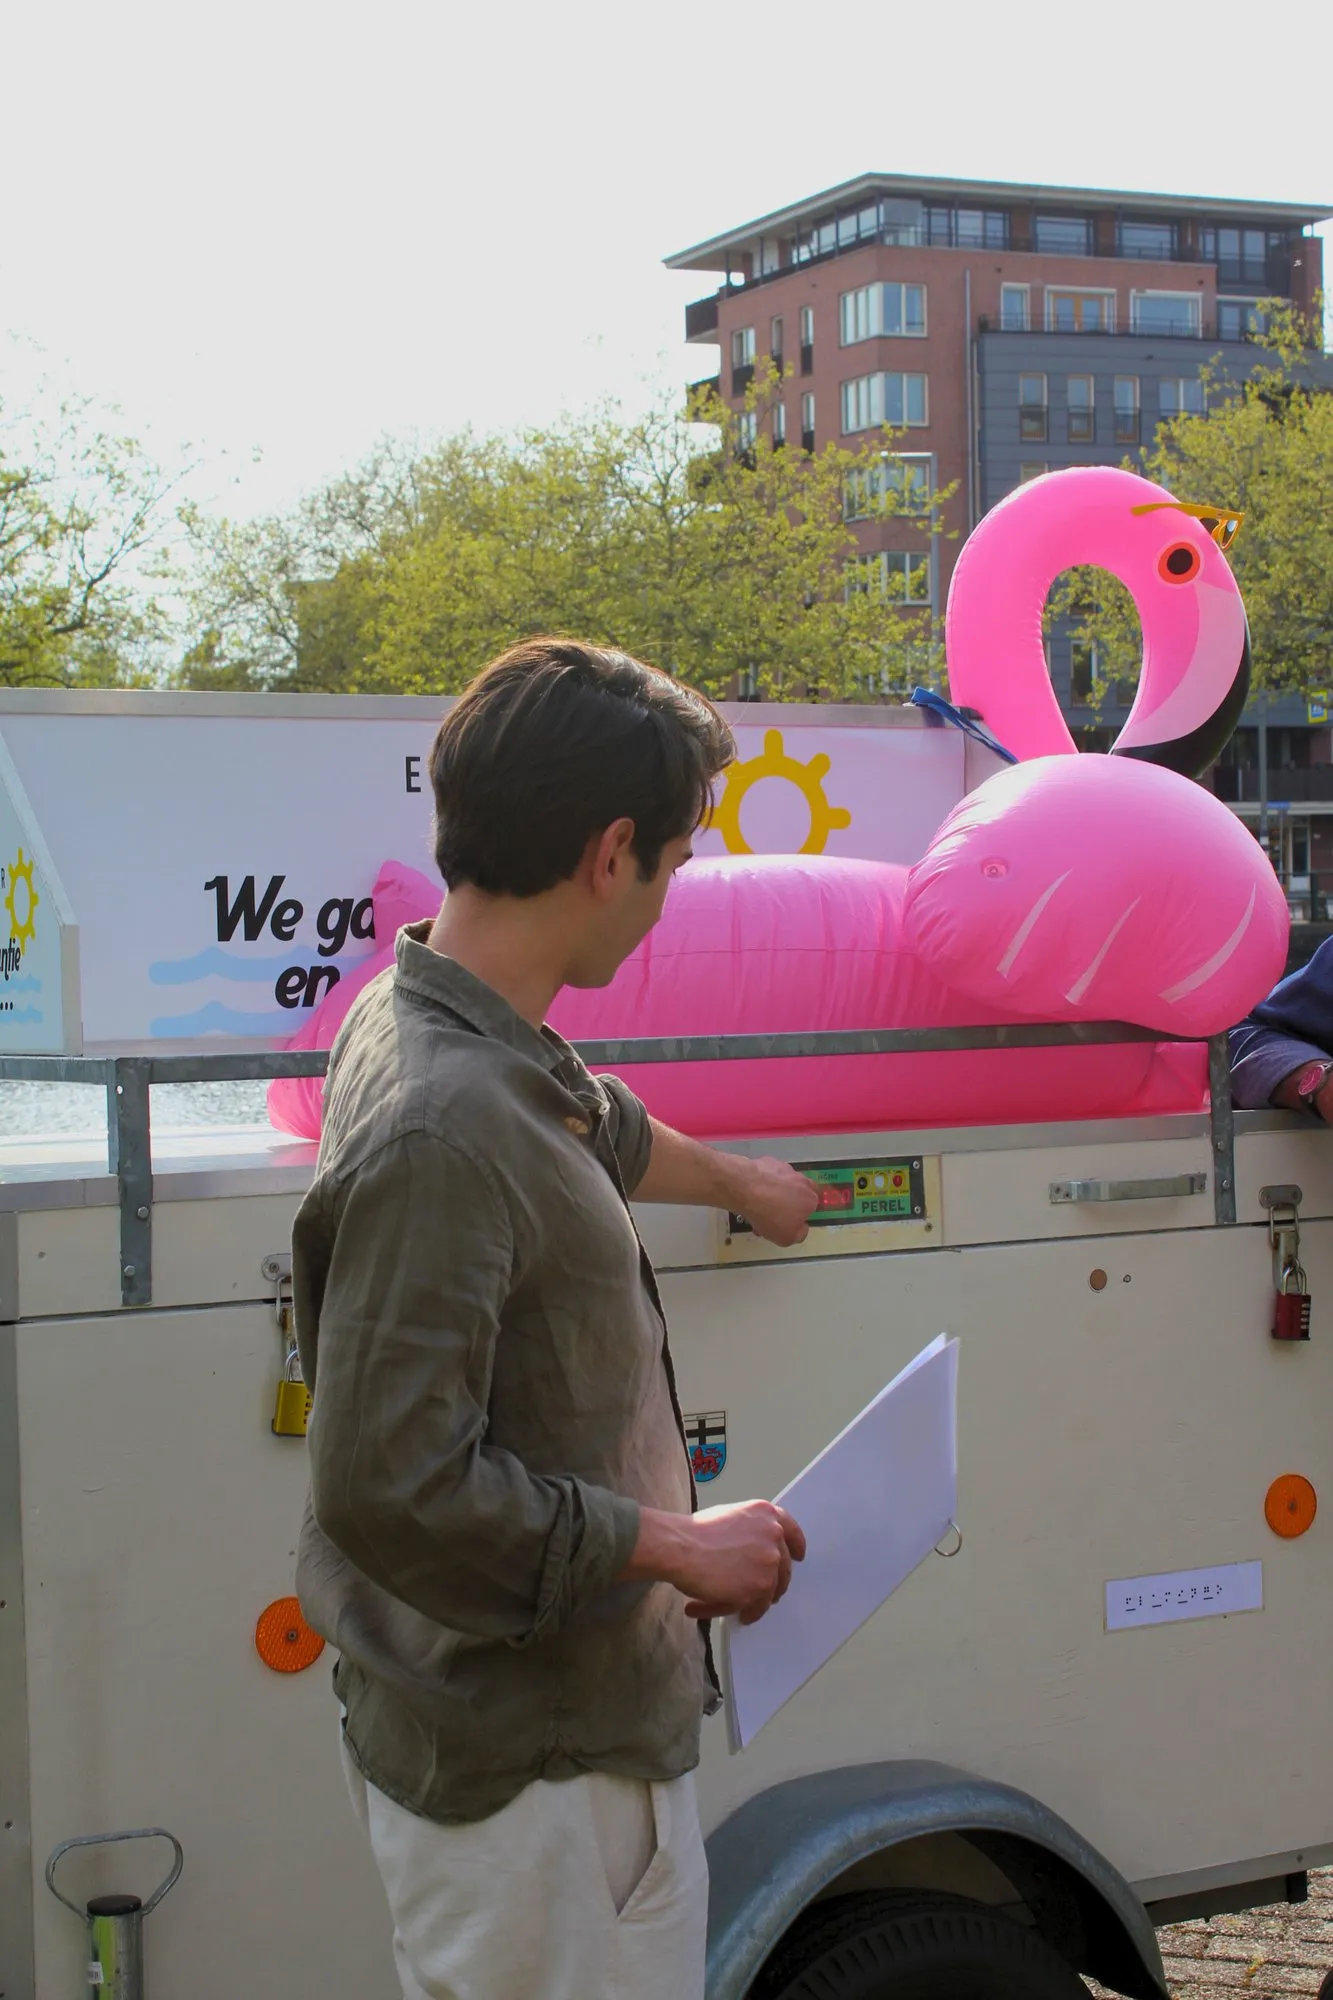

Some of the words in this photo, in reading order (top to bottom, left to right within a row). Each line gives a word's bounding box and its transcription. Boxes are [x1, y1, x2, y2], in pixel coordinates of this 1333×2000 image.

[204, 875, 304, 942] We
[0, 937, 21, 981] ntie
[274, 965, 341, 1009] en
[861, 1199, 905, 1213] PEREL
